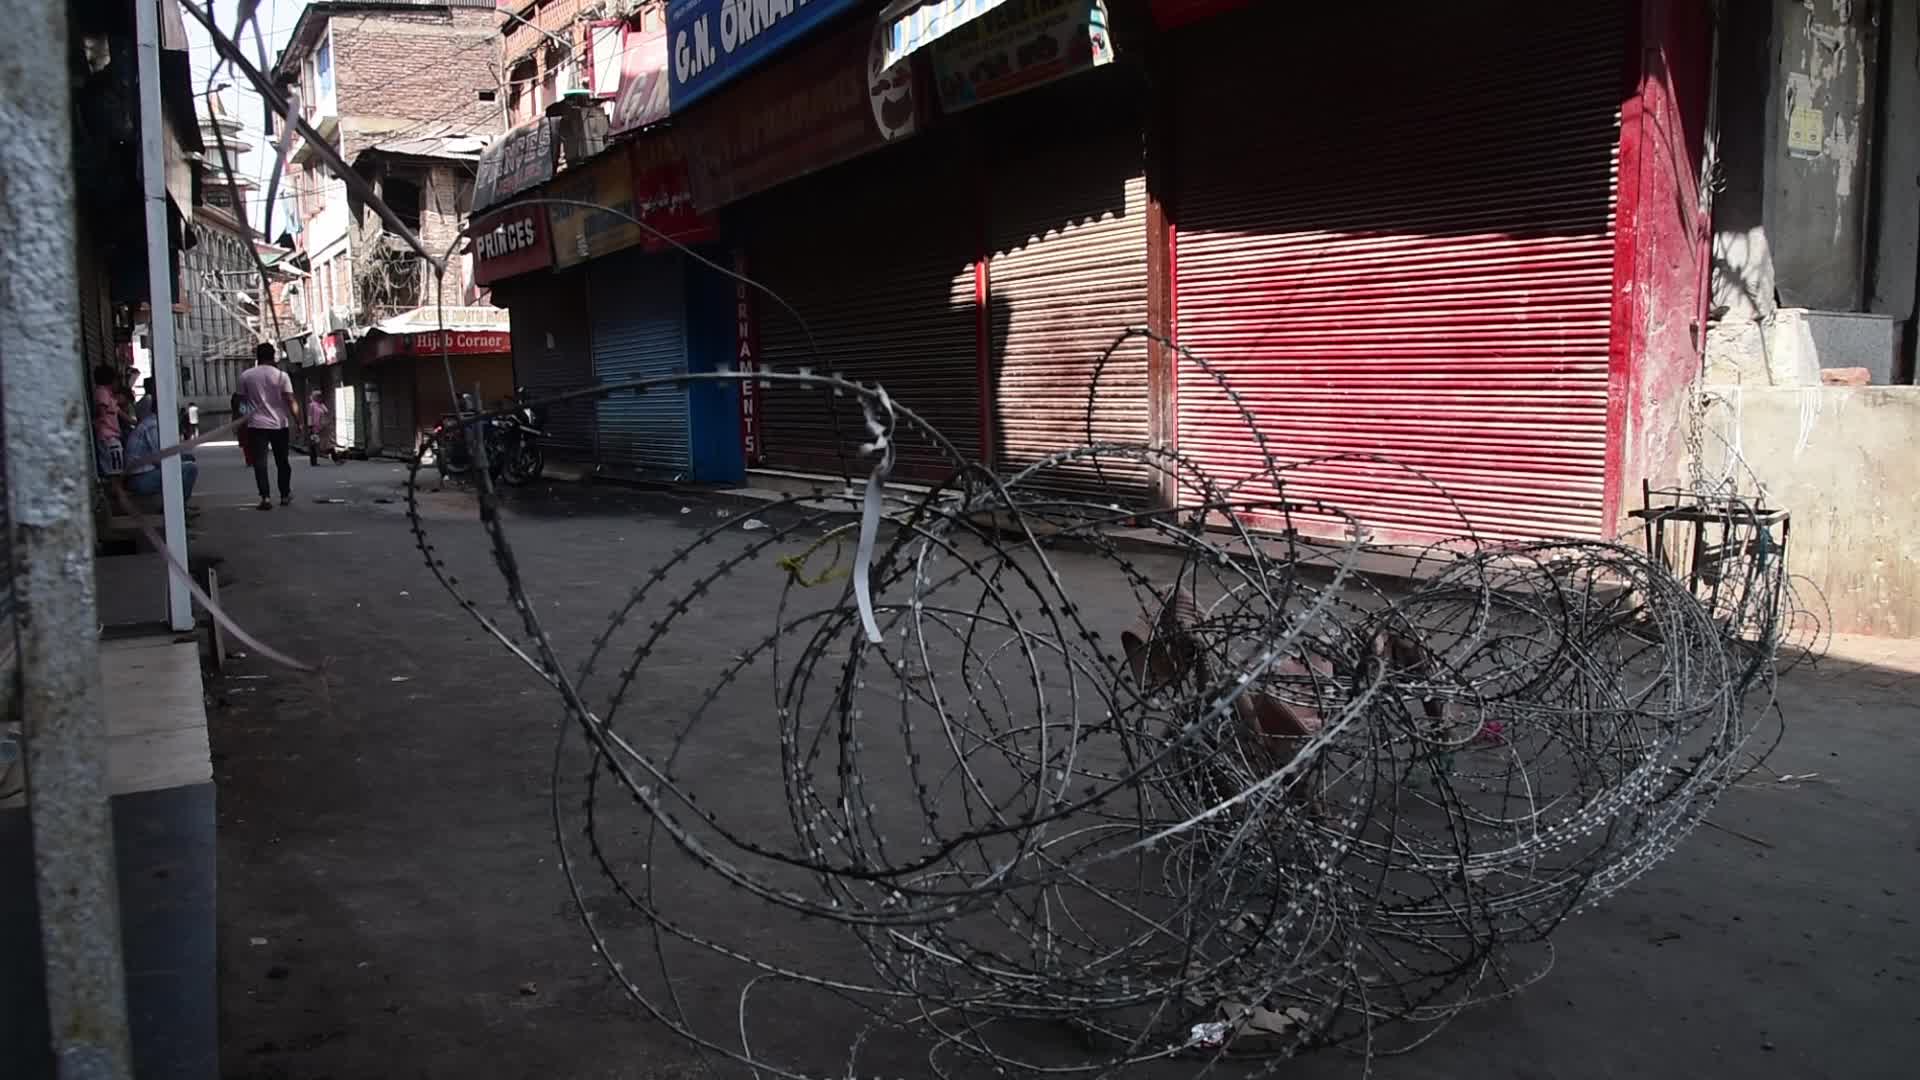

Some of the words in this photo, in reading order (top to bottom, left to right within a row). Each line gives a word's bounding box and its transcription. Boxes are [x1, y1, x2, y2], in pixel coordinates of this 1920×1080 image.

[675, 10, 717, 84] G.N.
[476, 217, 535, 262] PRINCES
[417, 333, 453, 351] Hijb
[457, 333, 503, 348] Corner
